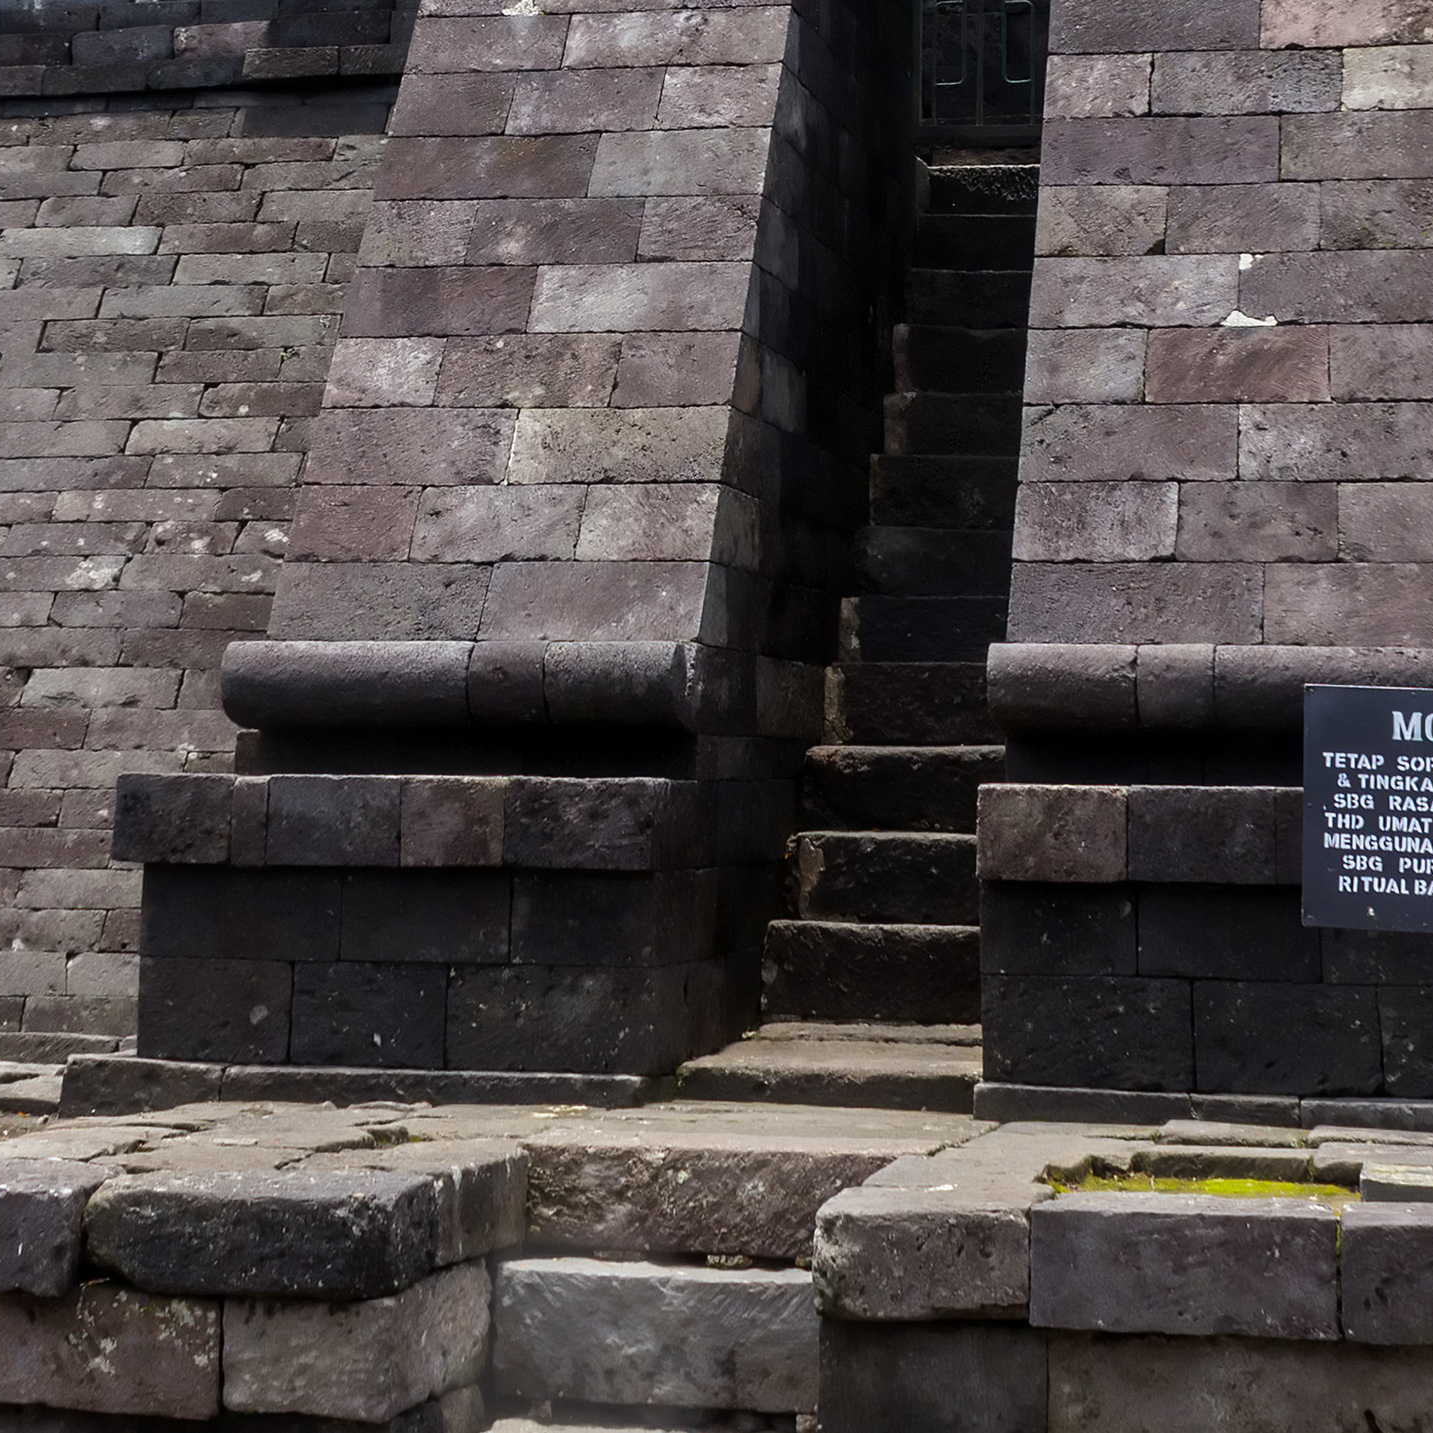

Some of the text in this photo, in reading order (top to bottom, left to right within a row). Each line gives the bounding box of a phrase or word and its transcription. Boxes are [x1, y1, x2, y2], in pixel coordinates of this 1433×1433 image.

[1322, 752, 1384, 769] TETAP
[1337, 774, 1351, 788] &
[1334, 794, 1374, 810] SBG
[1325, 813, 1364, 830] THD
[1378, 816, 1432, 834] UMAT
[1342, 855, 1382, 872] SBG
